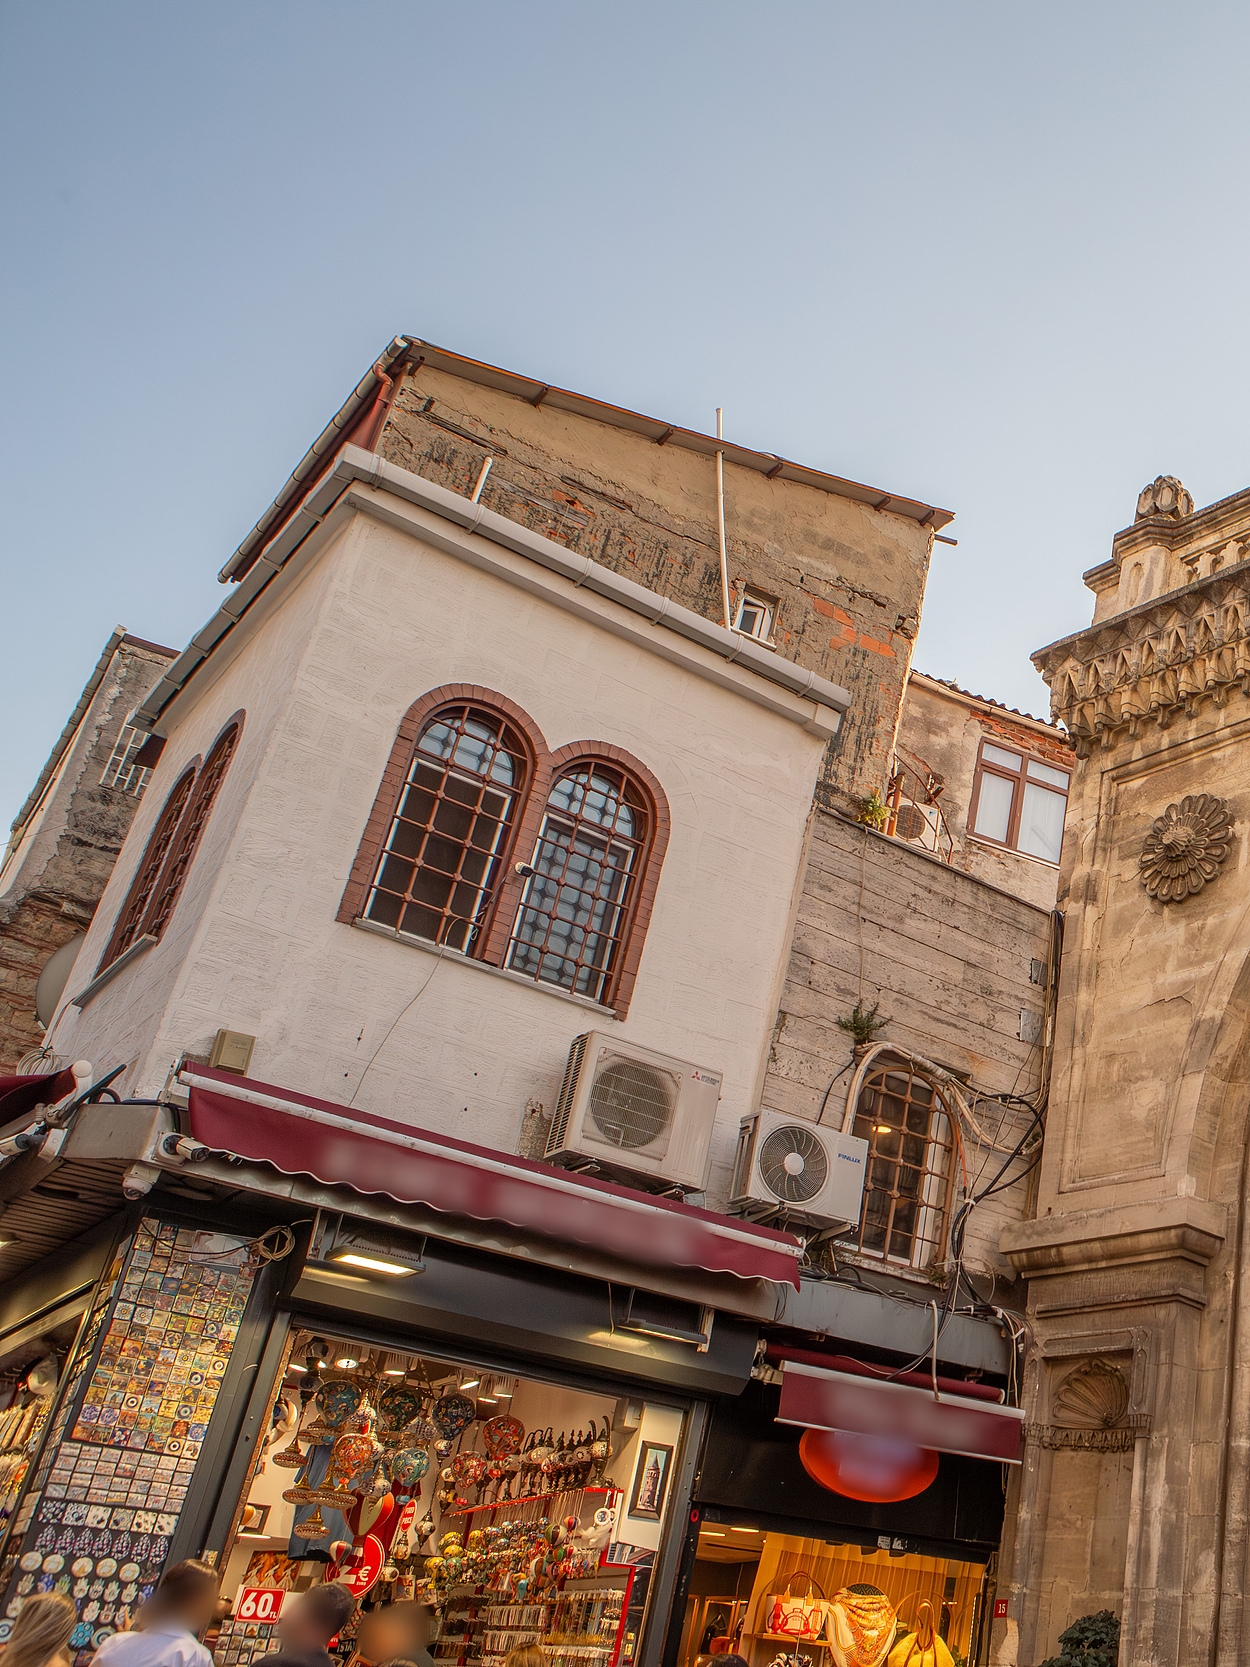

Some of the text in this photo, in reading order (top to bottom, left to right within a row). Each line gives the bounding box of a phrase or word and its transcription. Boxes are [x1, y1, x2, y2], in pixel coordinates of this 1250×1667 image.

[240, 1591, 278, 1619] 60 TL
[997, 1603, 1006, 1614] 15
